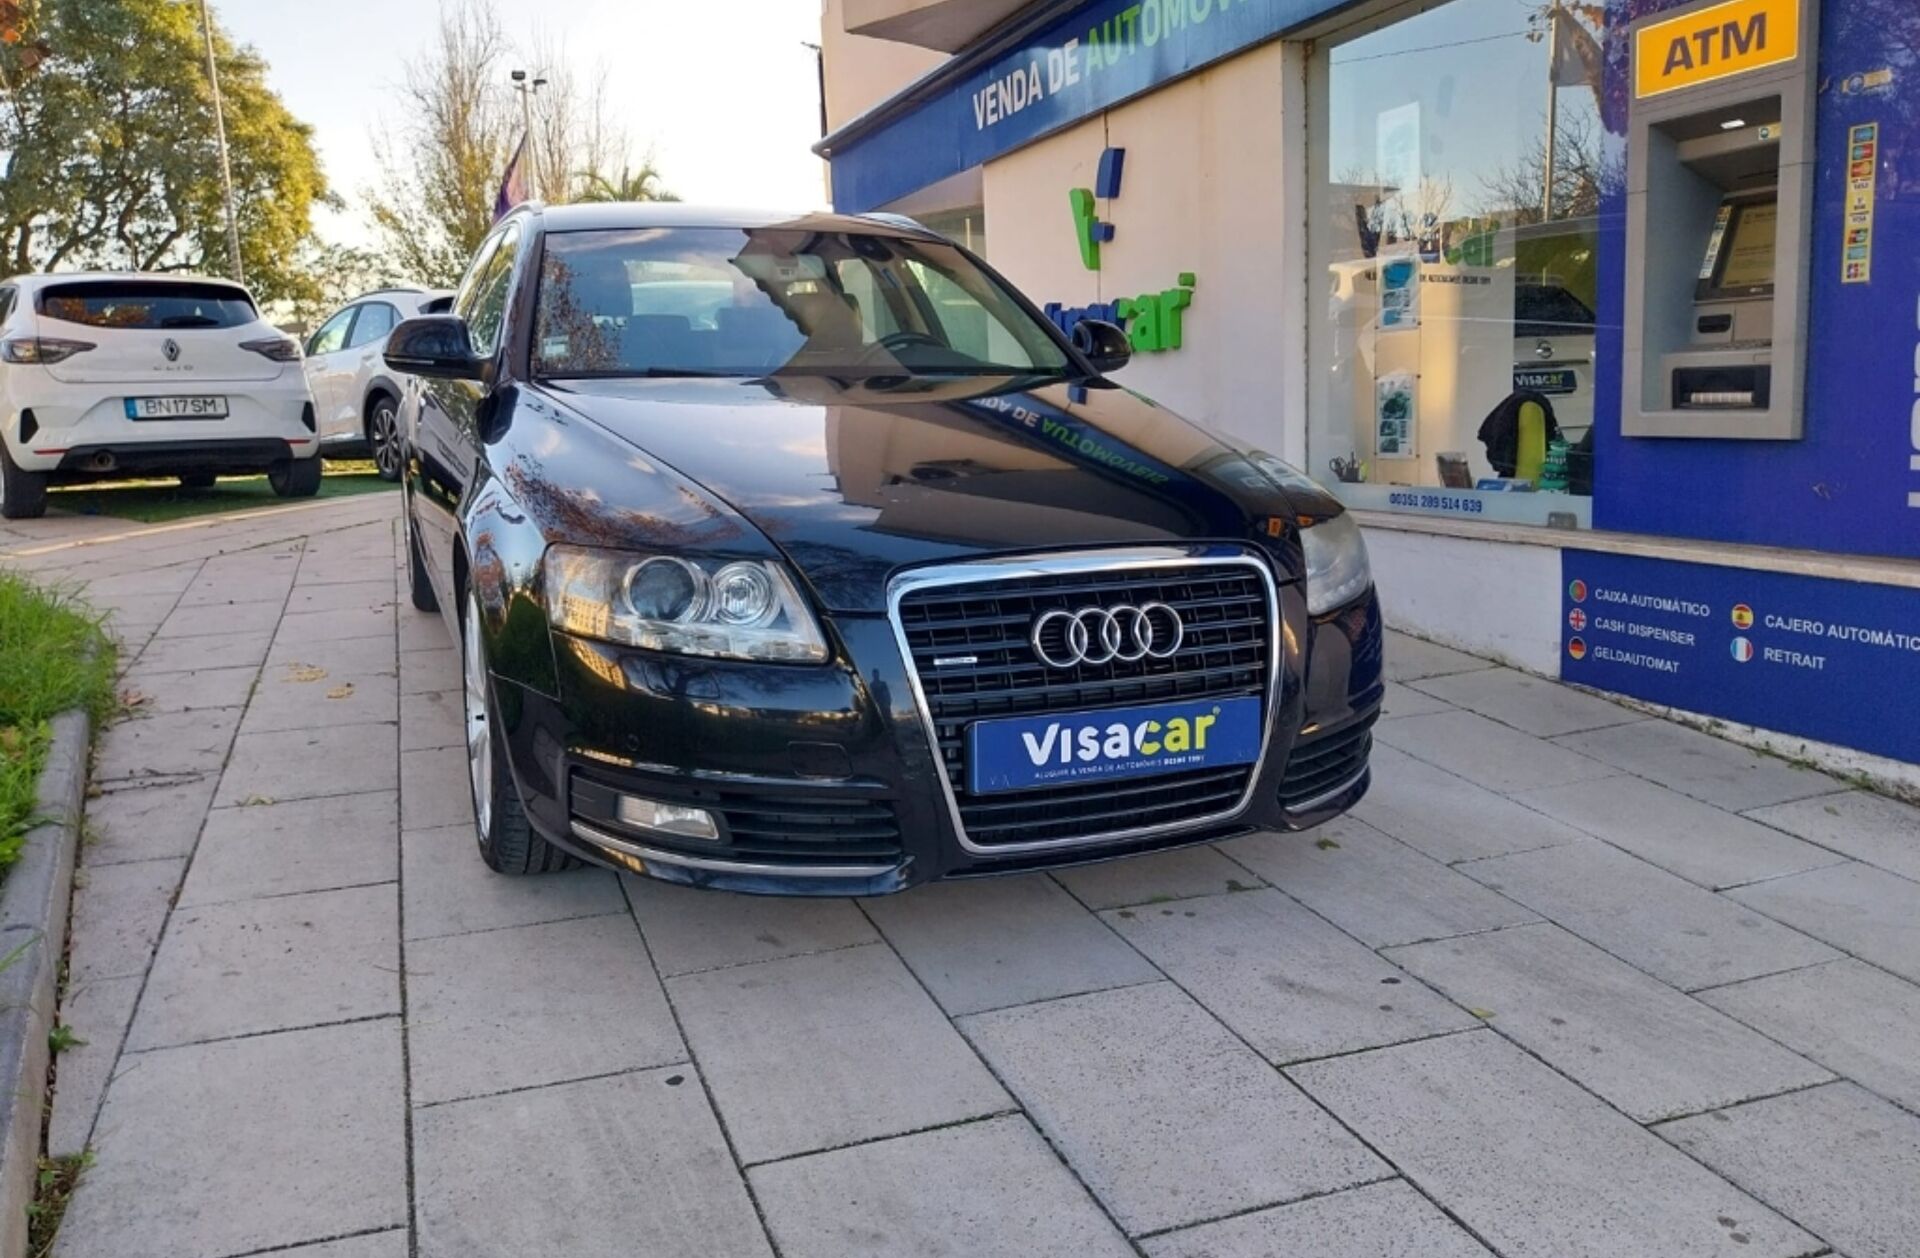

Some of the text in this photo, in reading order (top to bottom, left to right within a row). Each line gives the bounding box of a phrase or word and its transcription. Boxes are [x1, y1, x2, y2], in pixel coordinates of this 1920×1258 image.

[1662, 12, 1767, 76] ATM
[973, 62, 1043, 131] VENDA
[1048, 38, 1080, 95] DE
[1441, 497, 1460, 511] 514
[1462, 499, 1483, 513] 639
[1595, 589, 1628, 601] CAIXA
[1595, 617, 1695, 646] CASH DISPENSER
[1765, 615, 1824, 635] CAJERO
[1594, 646, 1680, 673] GELDAUTOMAT
[1763, 647, 1826, 670] RETRAIT
